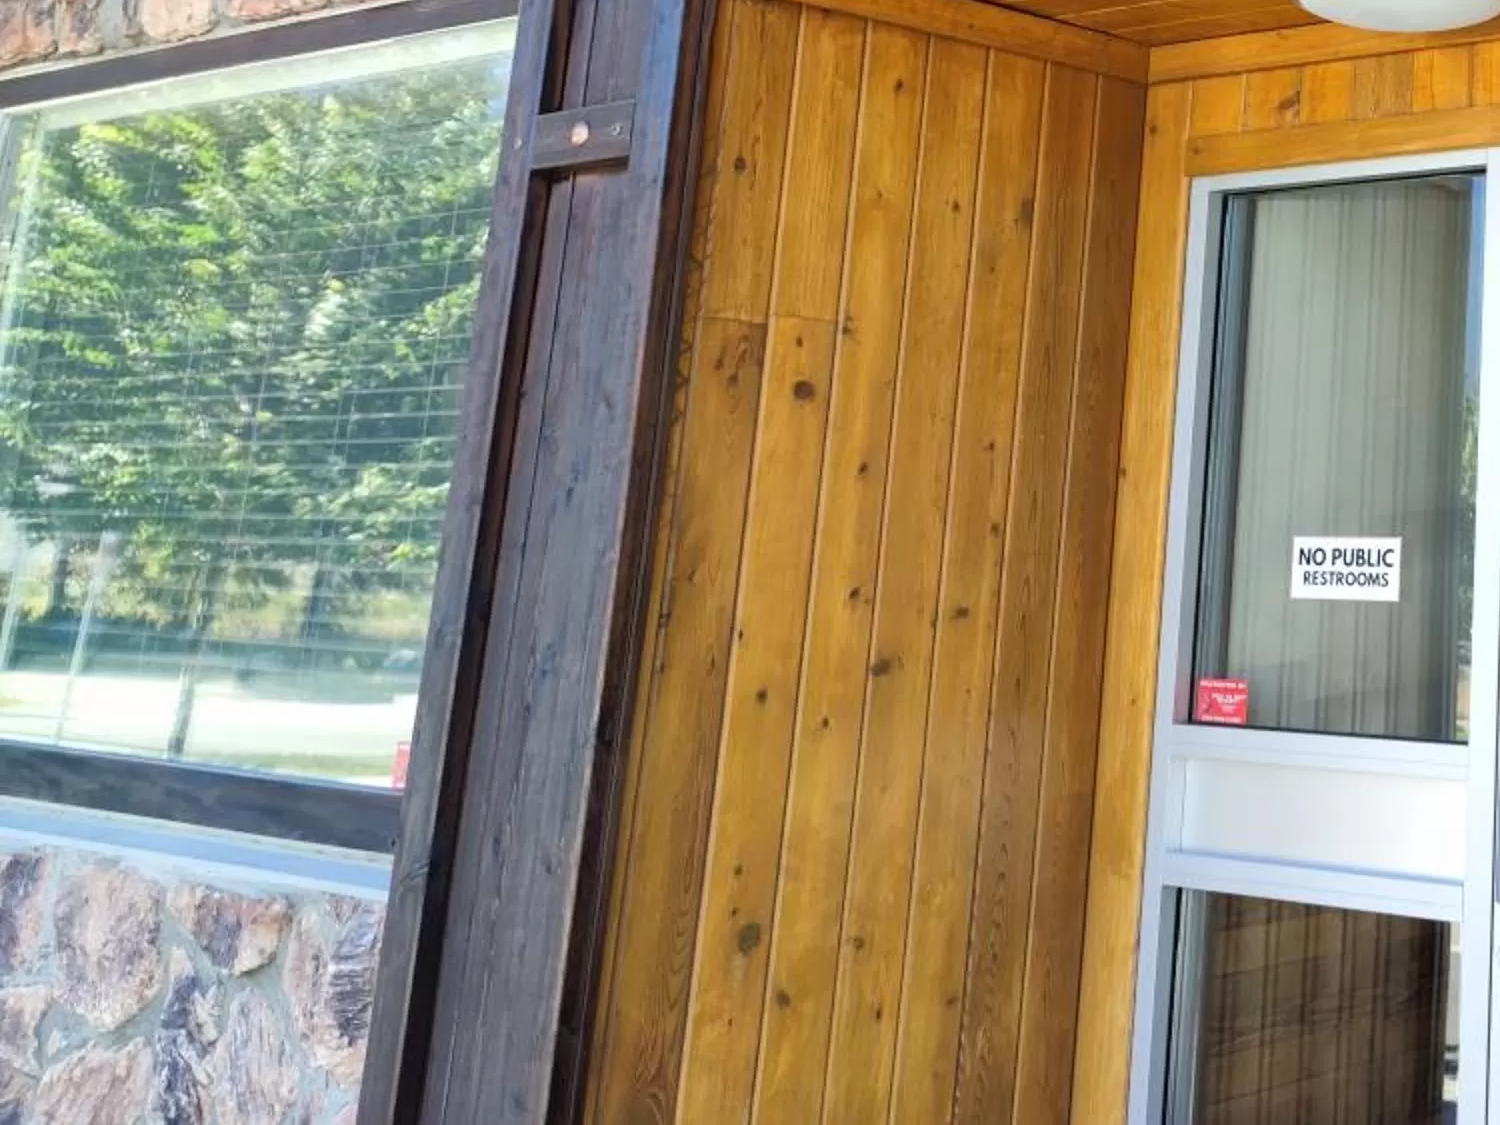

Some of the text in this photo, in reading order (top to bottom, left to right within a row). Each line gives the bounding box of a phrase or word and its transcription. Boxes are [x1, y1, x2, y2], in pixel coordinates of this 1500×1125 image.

[1298, 547, 1395, 567] NO PUBLIC
[1303, 571, 1389, 587] RESTROOMS
